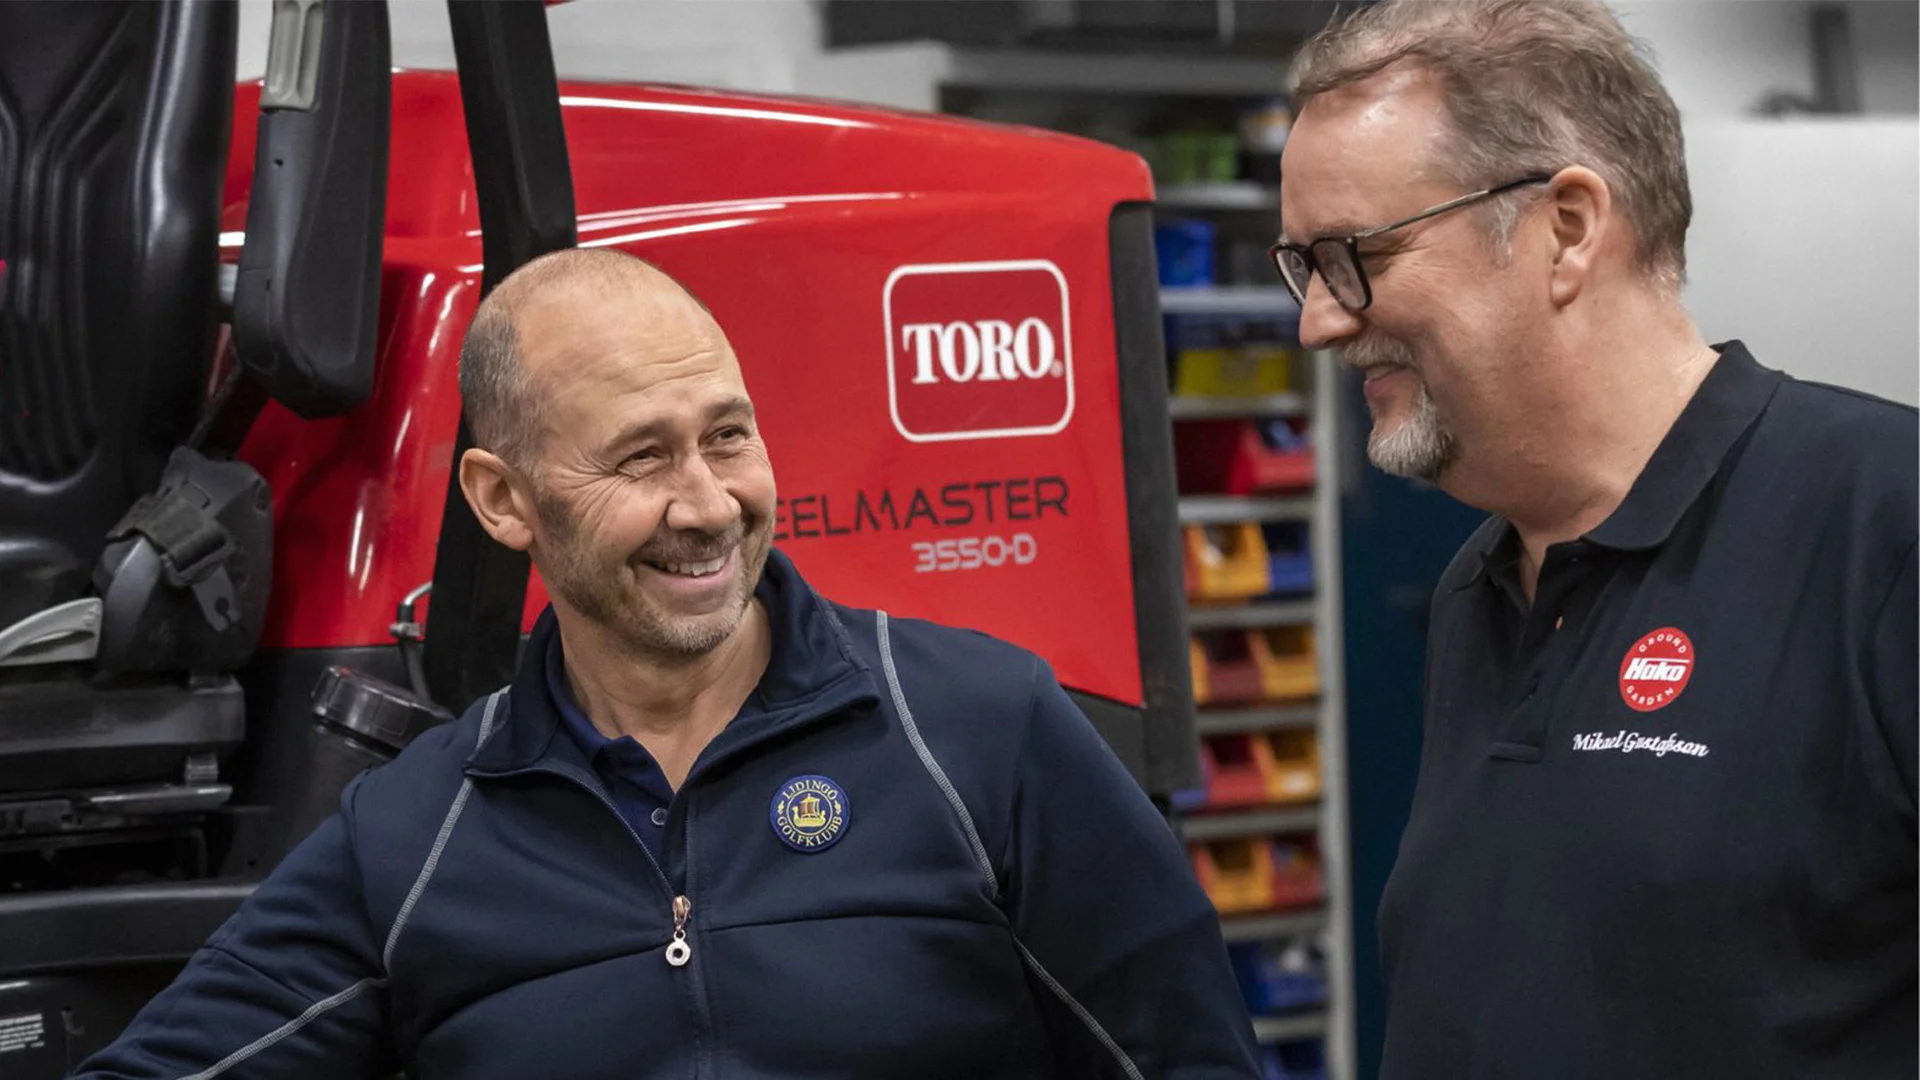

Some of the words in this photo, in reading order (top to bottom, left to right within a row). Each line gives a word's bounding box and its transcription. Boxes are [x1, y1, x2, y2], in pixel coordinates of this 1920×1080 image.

[1638, 633, 1687, 654] GROUND
[1623, 657, 1690, 682] Hako
[1626, 685, 1674, 706] GARDEN
[1572, 730, 1626, 751] Mikael
[1621, 731, 1710, 758] Gustafsson
[777, 816, 843, 847] GOLFKLUBB
